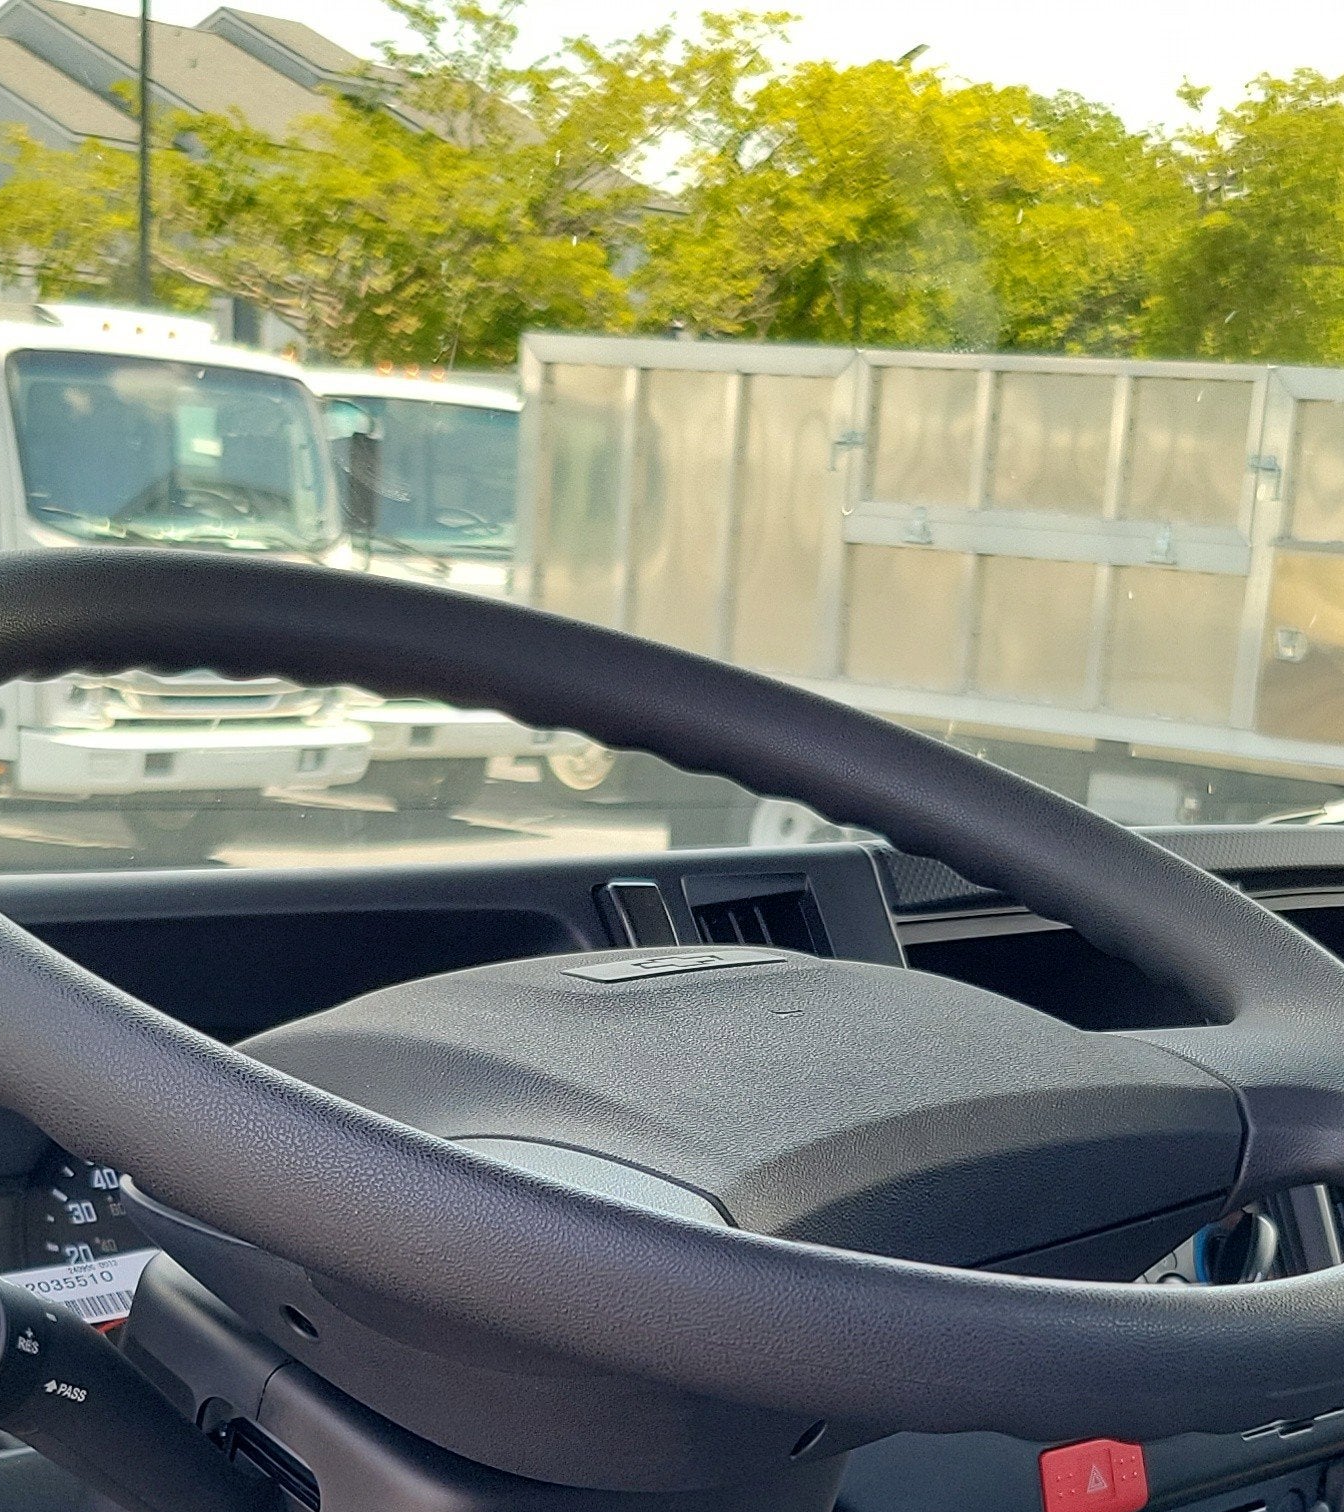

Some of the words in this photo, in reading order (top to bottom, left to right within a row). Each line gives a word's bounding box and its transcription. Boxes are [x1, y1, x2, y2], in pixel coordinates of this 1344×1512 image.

[92, 1168, 119, 1190] 40
[67, 1201, 98, 1225] 30
[65, 1243, 94, 1265] 20
[17, 1336, 40, 1355] RES
[56, 1383, 88, 1403] PASS
